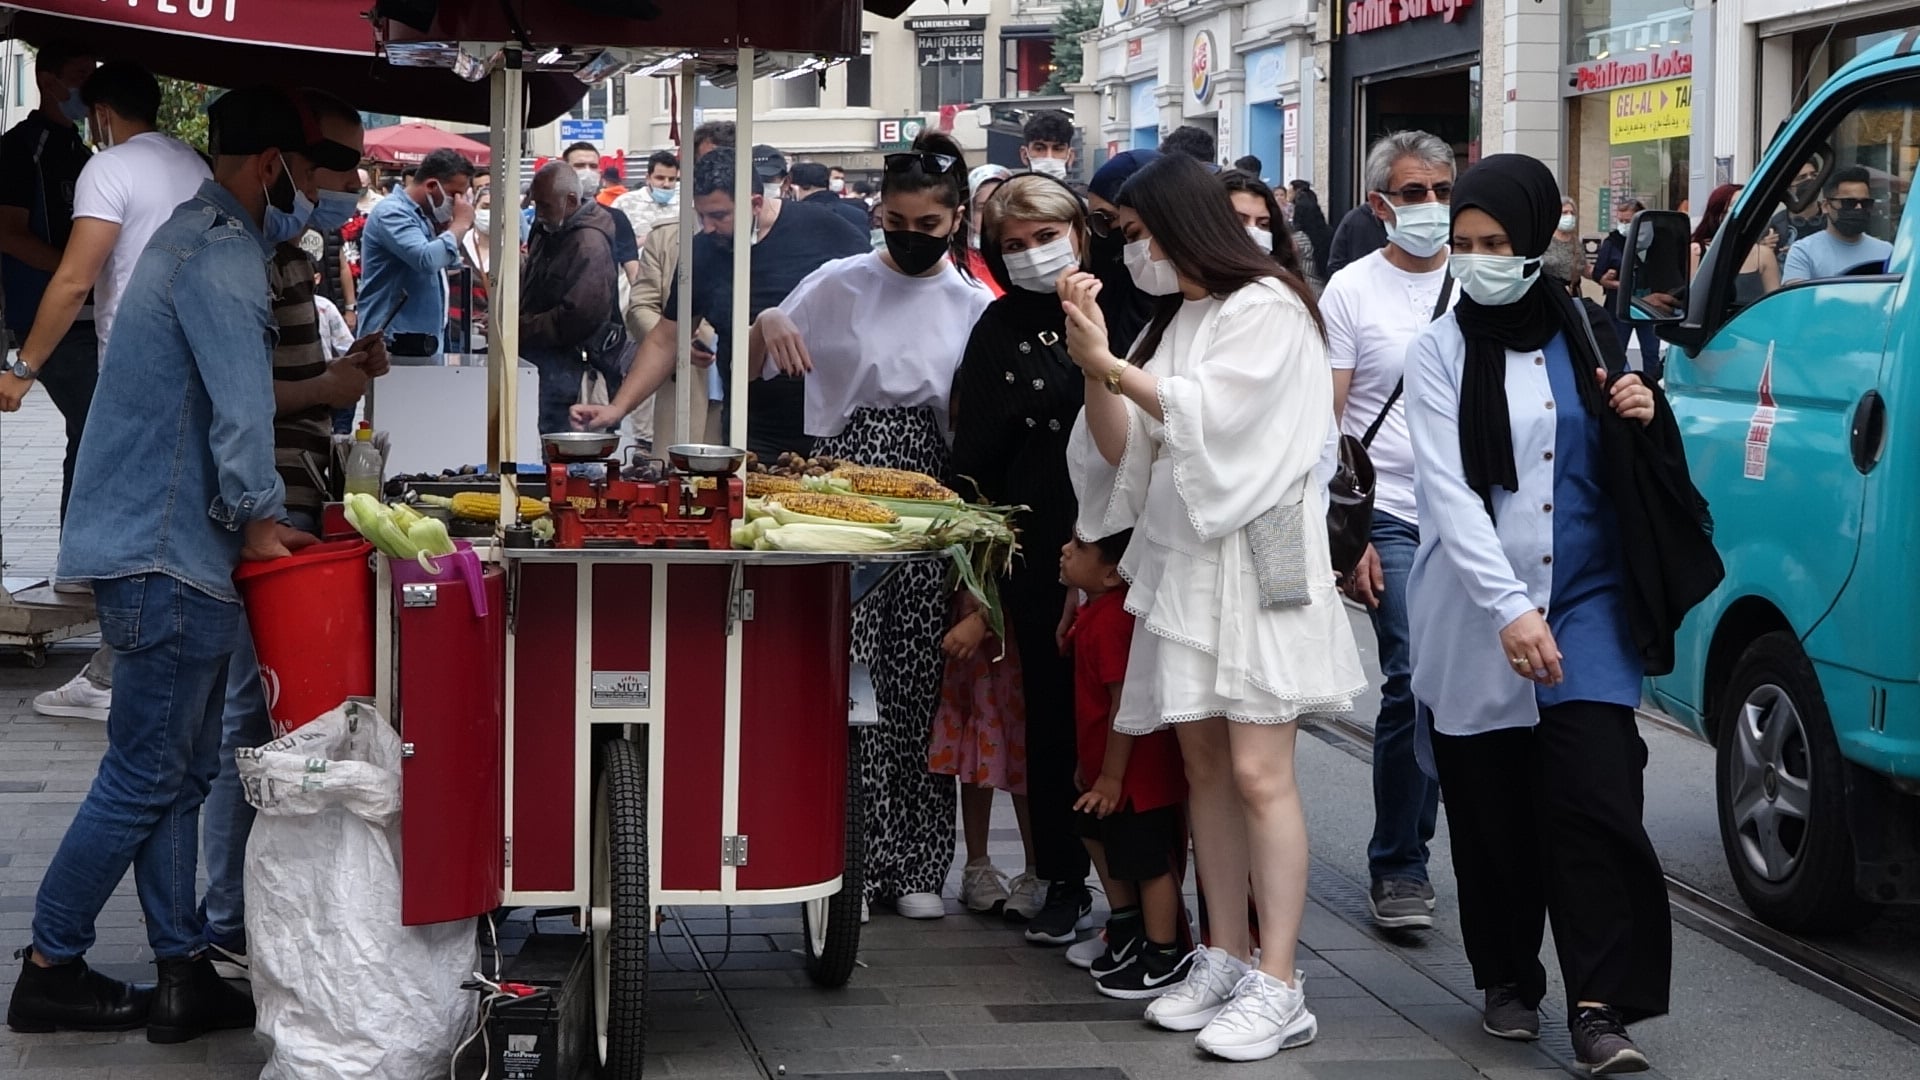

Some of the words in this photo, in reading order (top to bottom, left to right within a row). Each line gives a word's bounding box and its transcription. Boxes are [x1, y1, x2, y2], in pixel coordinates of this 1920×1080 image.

[1399, 0, 1463, 23] Saray
[1577, 61, 1647, 91] Pehlivan
[1616, 90, 1652, 118] GEL-AL
[884, 123, 896, 140] E
[617, 682, 642, 692] MUT
